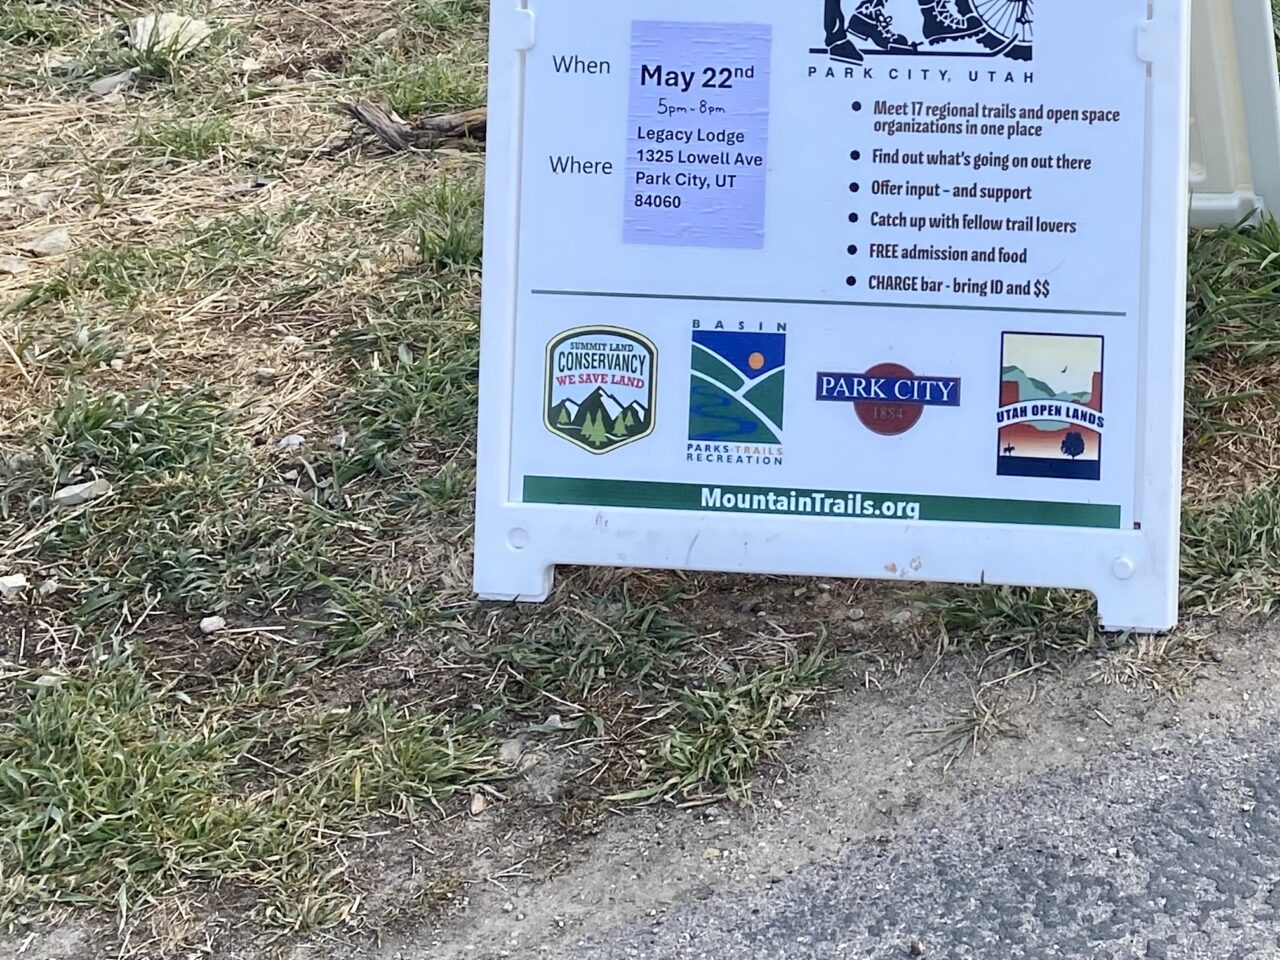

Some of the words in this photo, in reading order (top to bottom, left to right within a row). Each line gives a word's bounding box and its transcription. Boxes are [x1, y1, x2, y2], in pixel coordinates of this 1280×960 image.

[553, 56, 611, 75] When
[808, 67, 873, 80] PARK
[969, 71, 1034, 84] UTAH
[640, 65, 695, 92] May
[701, 65, 754, 89] 22nd
[874, 101, 908, 116] Meet
[912, 102, 922, 116] 17
[926, 103, 979, 119] regional
[982, 104, 1016, 119] trails
[1019, 105, 1043, 119] and
[1047, 108, 1079, 123] open
[1082, 109, 1120, 124] space
[637, 127, 693, 146] Legacy
[697, 128, 745, 147] Lodge
[874, 119, 962, 135] organizations
[966, 121, 977, 134] in
[981, 124, 1004, 135] one
[1007, 121, 1042, 139] place
[549, 156, 613, 175] Where
[637, 149, 674, 164] 1325
[678, 150, 730, 166] Lowell
[733, 152, 763, 166] Ave
[872, 149, 898, 164] Find
[902, 151, 924, 165] out
[927, 151, 970, 166] what's
[974, 152, 1009, 170] going
[1012, 155, 1028, 168] on
[1031, 155, 1053, 168] out
[1056, 154, 1091, 170] there
[636, 171, 671, 186] Park
[675, 172, 712, 190] City,
[716, 174, 736, 188] UT
[872, 180, 902, 195] Offer
[905, 182, 940, 199] input
[953, 183, 977, 198] and
[980, 185, 1032, 202] support
[634, 194, 681, 209] 84060
[871, 211, 906, 227] Catch
[909, 217, 926, 231] up
[929, 214, 959, 229] with
[962, 214, 1002, 230] fellow
[1006, 217, 1033, 231] trail
[1036, 217, 1076, 233] lovers
[869, 244, 898, 258] FREE
[901, 245, 968, 261] admission
[971, 247, 995, 262] and
[999, 248, 1027, 263] food
[868, 275, 918, 291] CHARGE
[921, 277, 943, 291] bar
[953, 278, 987, 297] bring
[990, 280, 1003, 294] ID
[1006, 280, 1030, 295] and
[1033, 280, 1050, 297] $$
[692, 320, 786, 331] BASIN
[570, 342, 608, 352] SUMMIT
[610, 342, 634, 352] LAND
[558, 352, 646, 376] CONSERVANCY
[556, 376, 576, 386] WE
[578, 374, 608, 384] SAVE
[611, 376, 645, 389] LAND
[821, 376, 886, 398] PARK
[894, 380, 955, 402] CITY
[996, 405, 1028, 422] UTAH
[1032, 404, 1062, 417] OPEN
[1066, 407, 1104, 428] LANDS
[687, 453, 782, 465] RECREATION
[701, 487, 920, 520] MountainTrails.org
